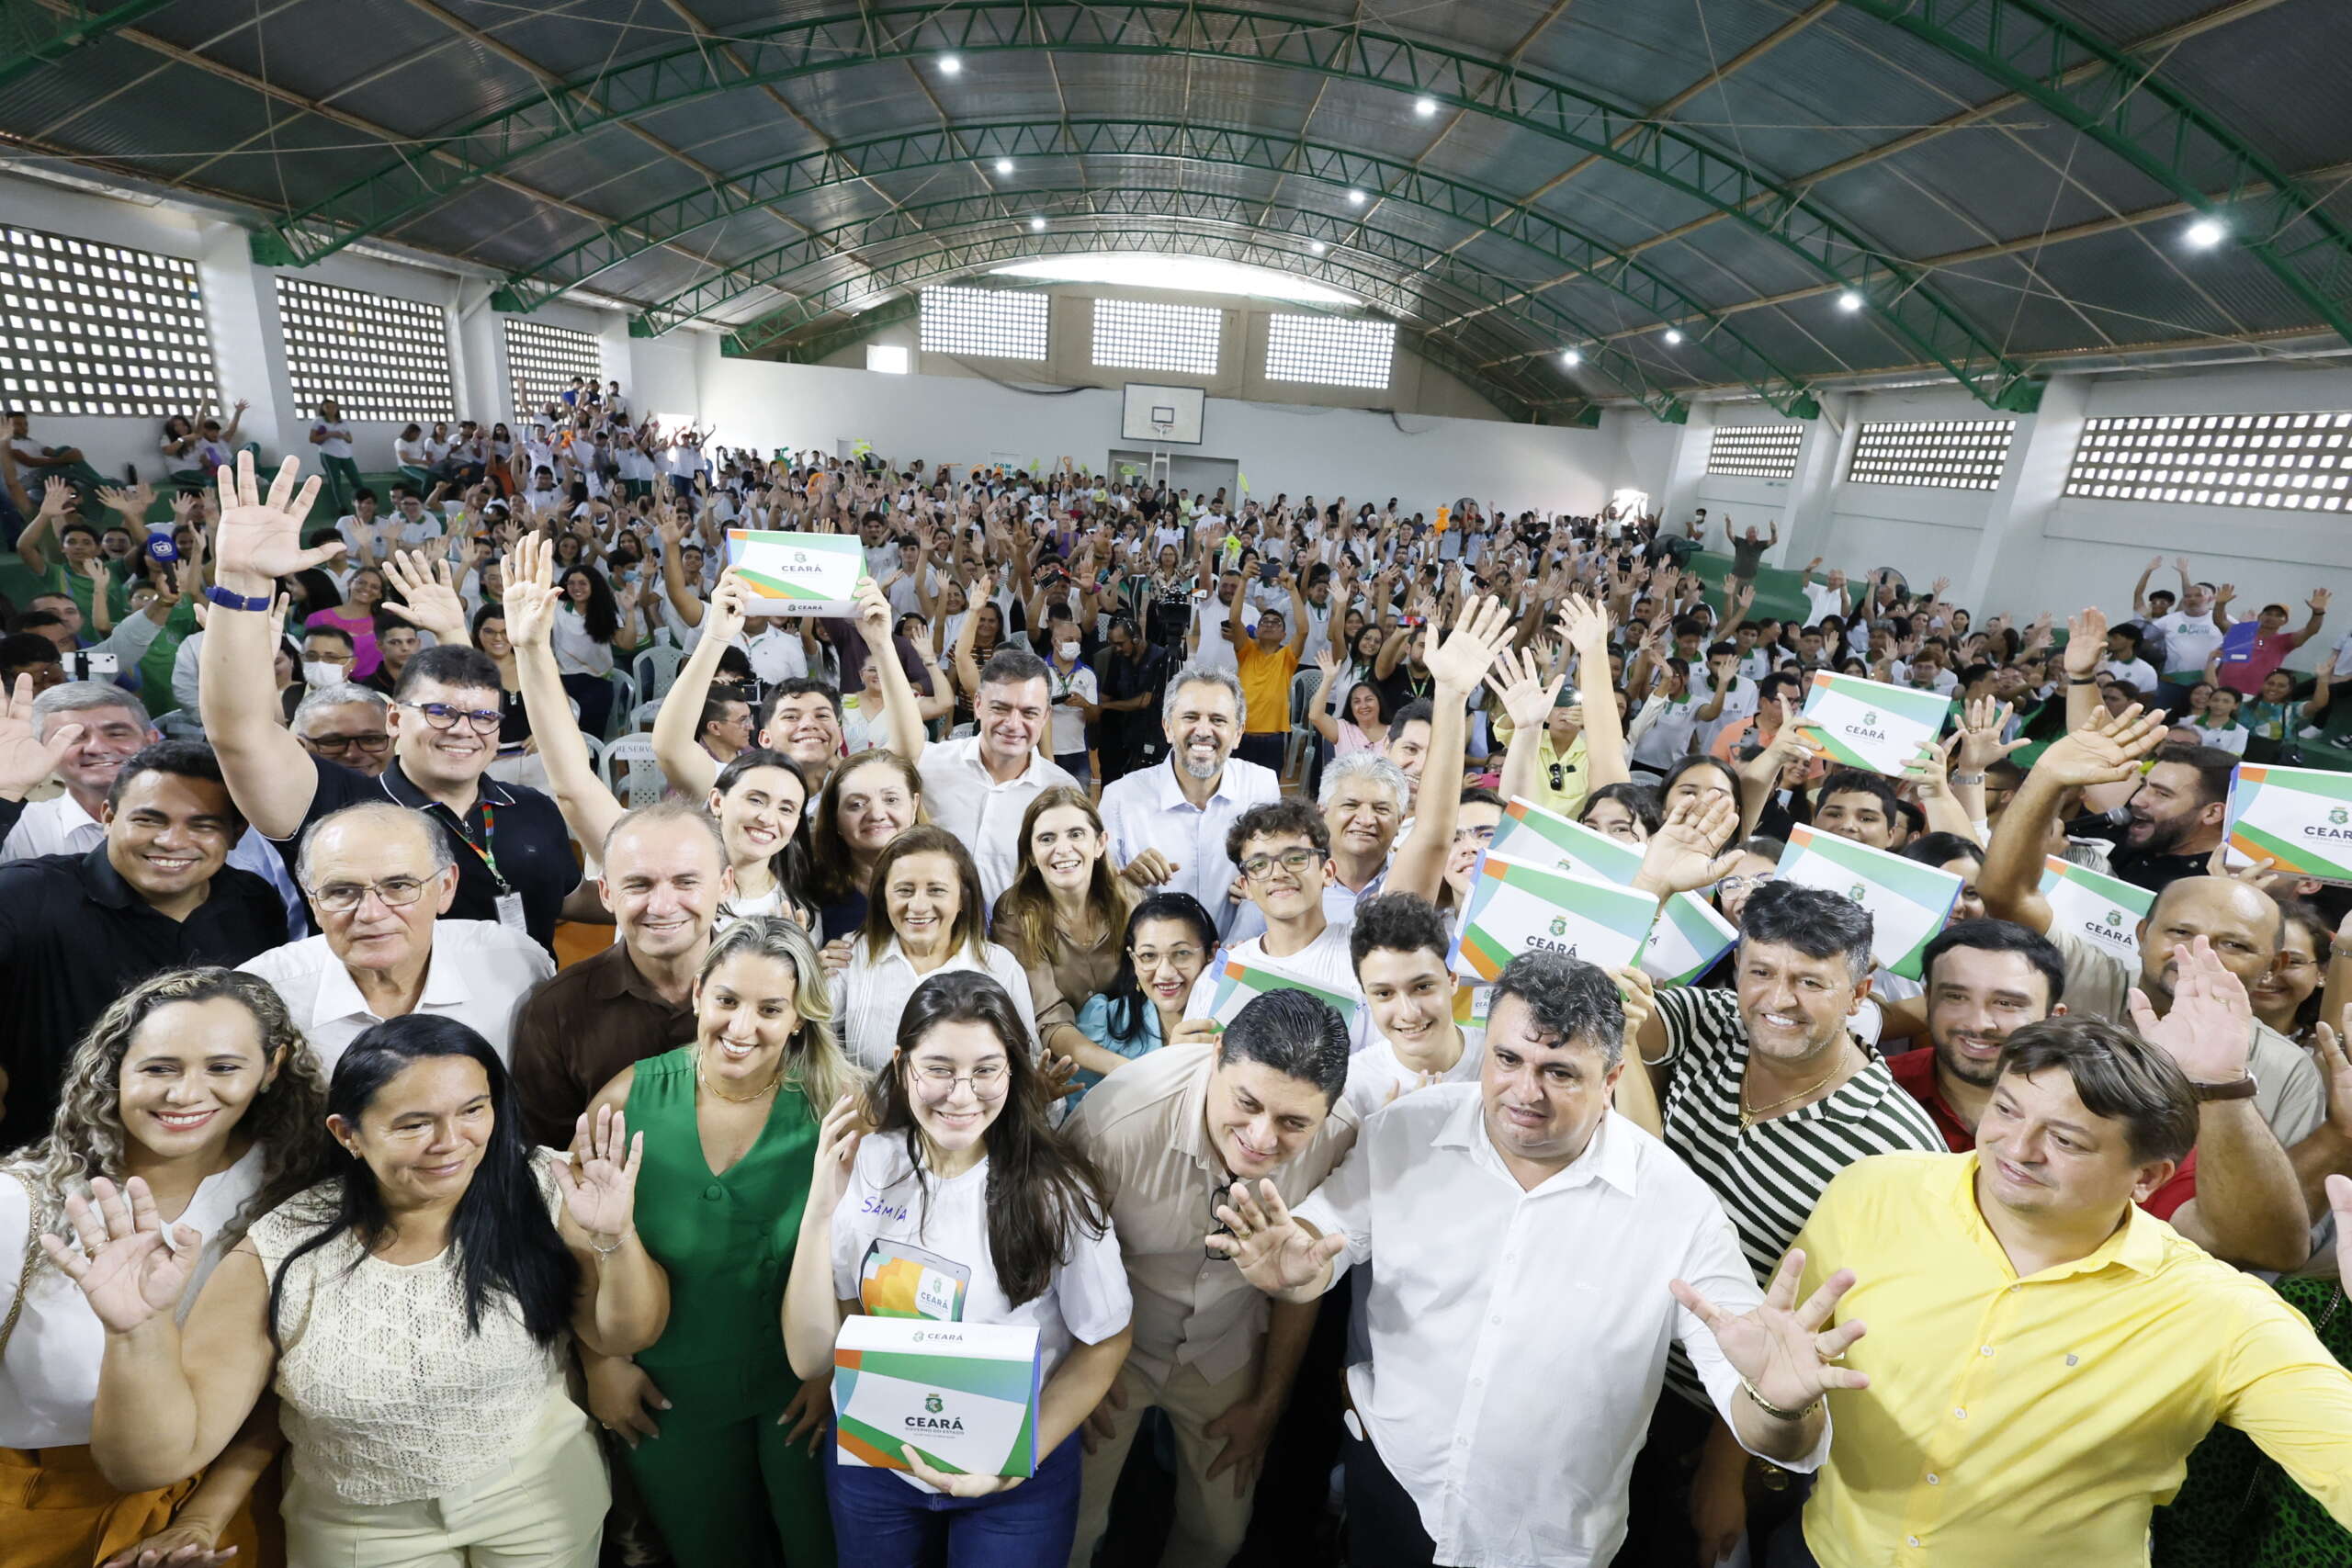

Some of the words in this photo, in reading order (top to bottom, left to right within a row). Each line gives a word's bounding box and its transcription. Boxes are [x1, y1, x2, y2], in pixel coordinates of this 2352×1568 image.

[781, 563, 822, 572] CEARÁ
[1845, 725, 1884, 740] CEARÁ
[2304, 826, 2352, 840] CEAR
[2086, 921, 2132, 946] CEARÁ
[1526, 935, 1577, 957] CEARÁ
[921, 1292, 948, 1310] CEARÁ
[927, 1332, 964, 1341] CEARÁ
[905, 1416, 964, 1431] CEARÁ
